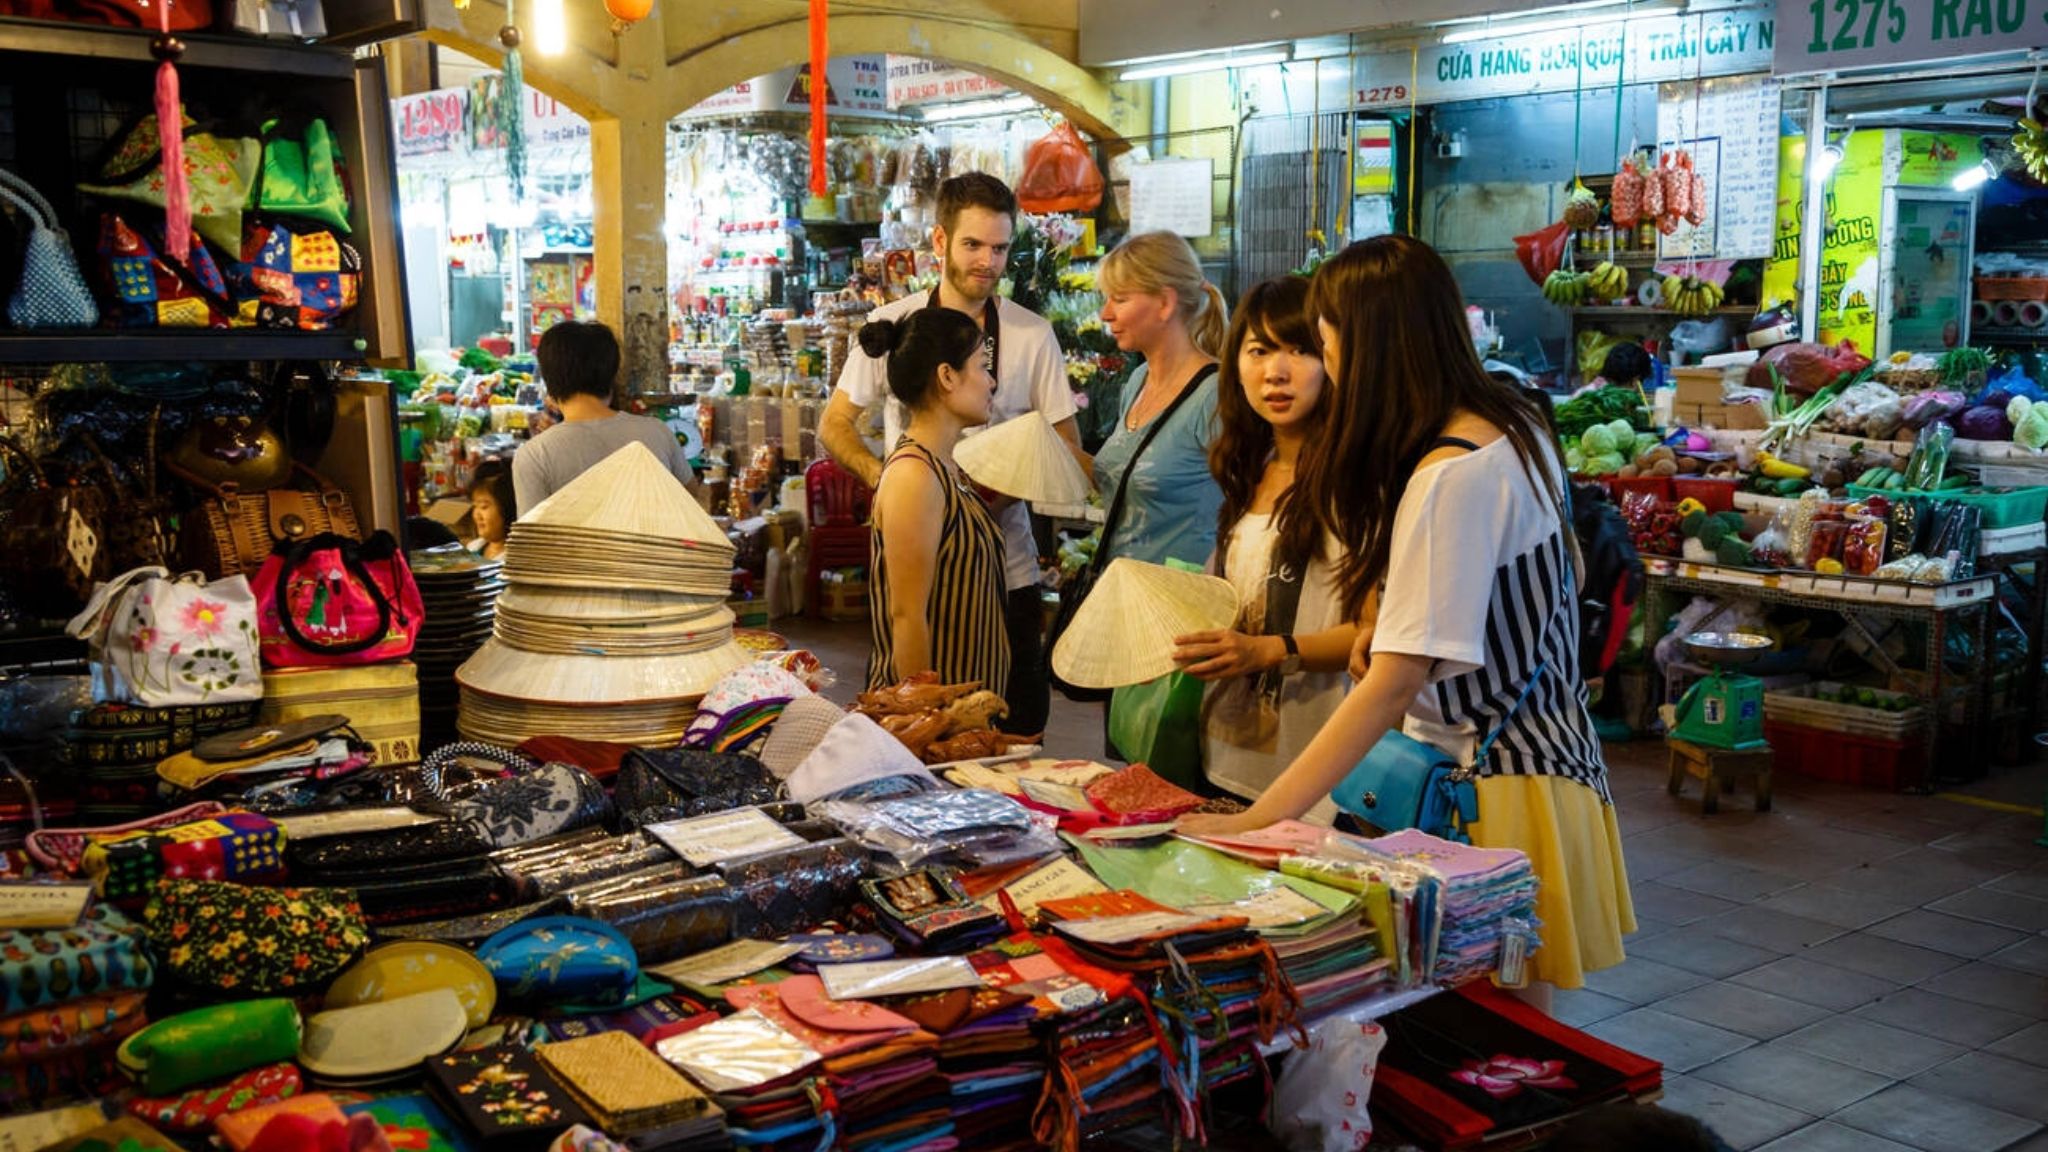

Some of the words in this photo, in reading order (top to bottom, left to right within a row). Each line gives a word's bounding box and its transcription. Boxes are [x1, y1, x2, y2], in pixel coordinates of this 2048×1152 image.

[1705, 17, 1750, 54] CÂY
[1807, 0, 1906, 54] 1275
[1931, 0, 2026, 40] RAU
[854, 88, 880, 98] TEA
[1357, 85, 1406, 103] 1279
